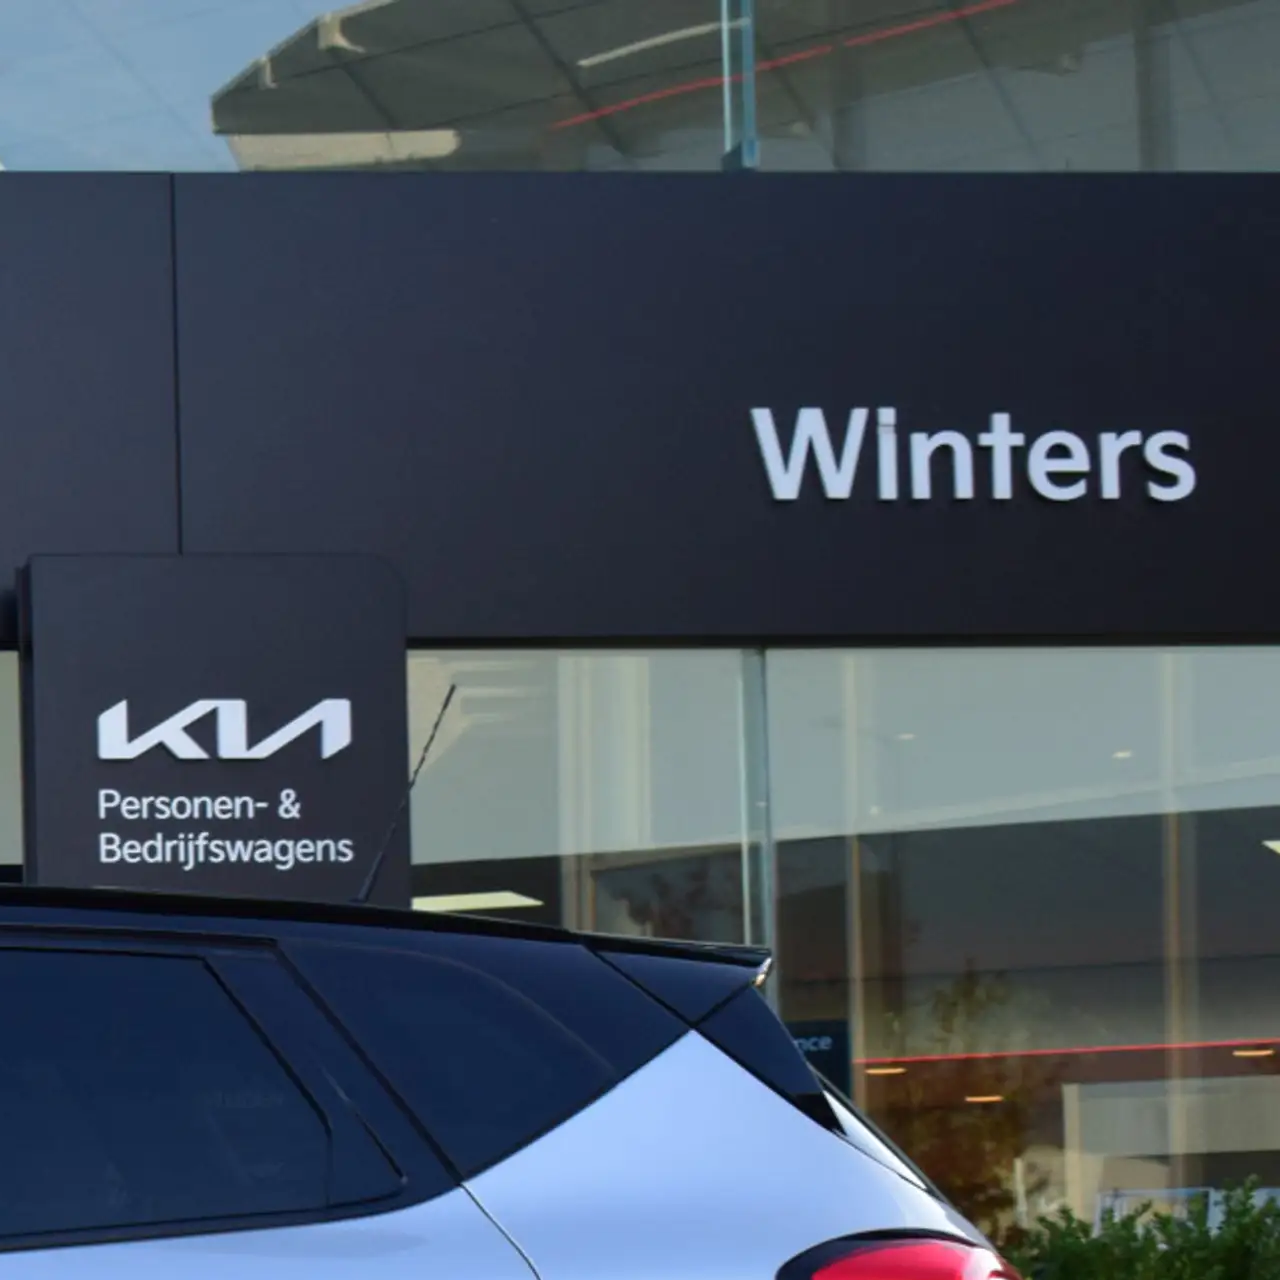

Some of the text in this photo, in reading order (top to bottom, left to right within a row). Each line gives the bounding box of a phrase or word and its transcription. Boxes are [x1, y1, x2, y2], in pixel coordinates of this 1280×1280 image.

[749, 406, 1197, 502] Winters
[97, 698, 352, 760] KIA
[97, 788, 302, 820] Personen- &
[98, 832, 355, 872] Bedrijfswagens
